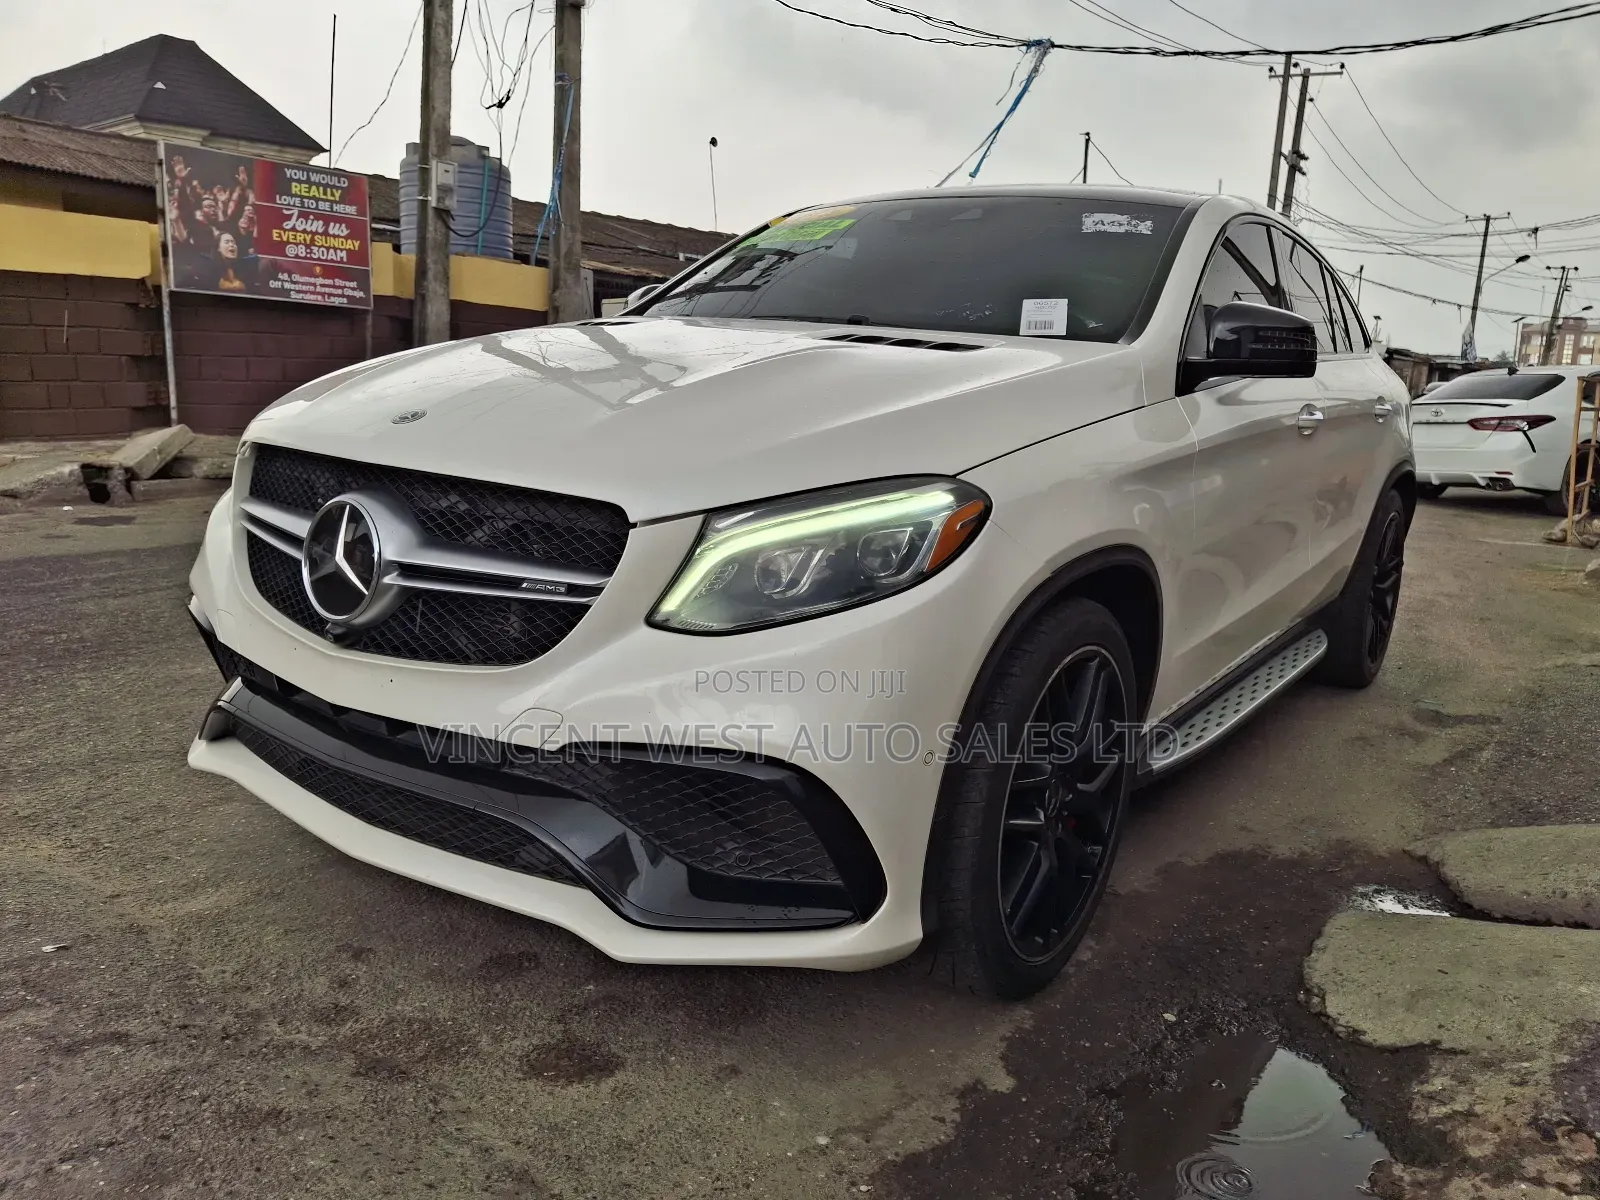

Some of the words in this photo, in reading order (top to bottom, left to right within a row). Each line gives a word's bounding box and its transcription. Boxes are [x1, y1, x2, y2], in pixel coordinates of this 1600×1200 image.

[284, 168, 307, 180] YOU
[309, 172, 348, 187] WOULD
[291, 182, 342, 201] REALLY
[276, 195, 301, 206] LOVE
[303, 199, 316, 208] TO
[318, 201, 331, 211] BE
[333, 204, 357, 215] HERE
[282, 209, 326, 233] Join
[328, 222, 350, 236] us
[272, 229, 312, 244] EVERY
[314, 234, 360, 250] SUNDAY
[285, 244, 347, 262] @8:30AM
[269, 280, 282, 289] Off
[283, 282, 314, 292] Western
[315, 286, 343, 295] Avenue
[334, 278, 358, 288] Street
[325, 294, 348, 304] Lagos
